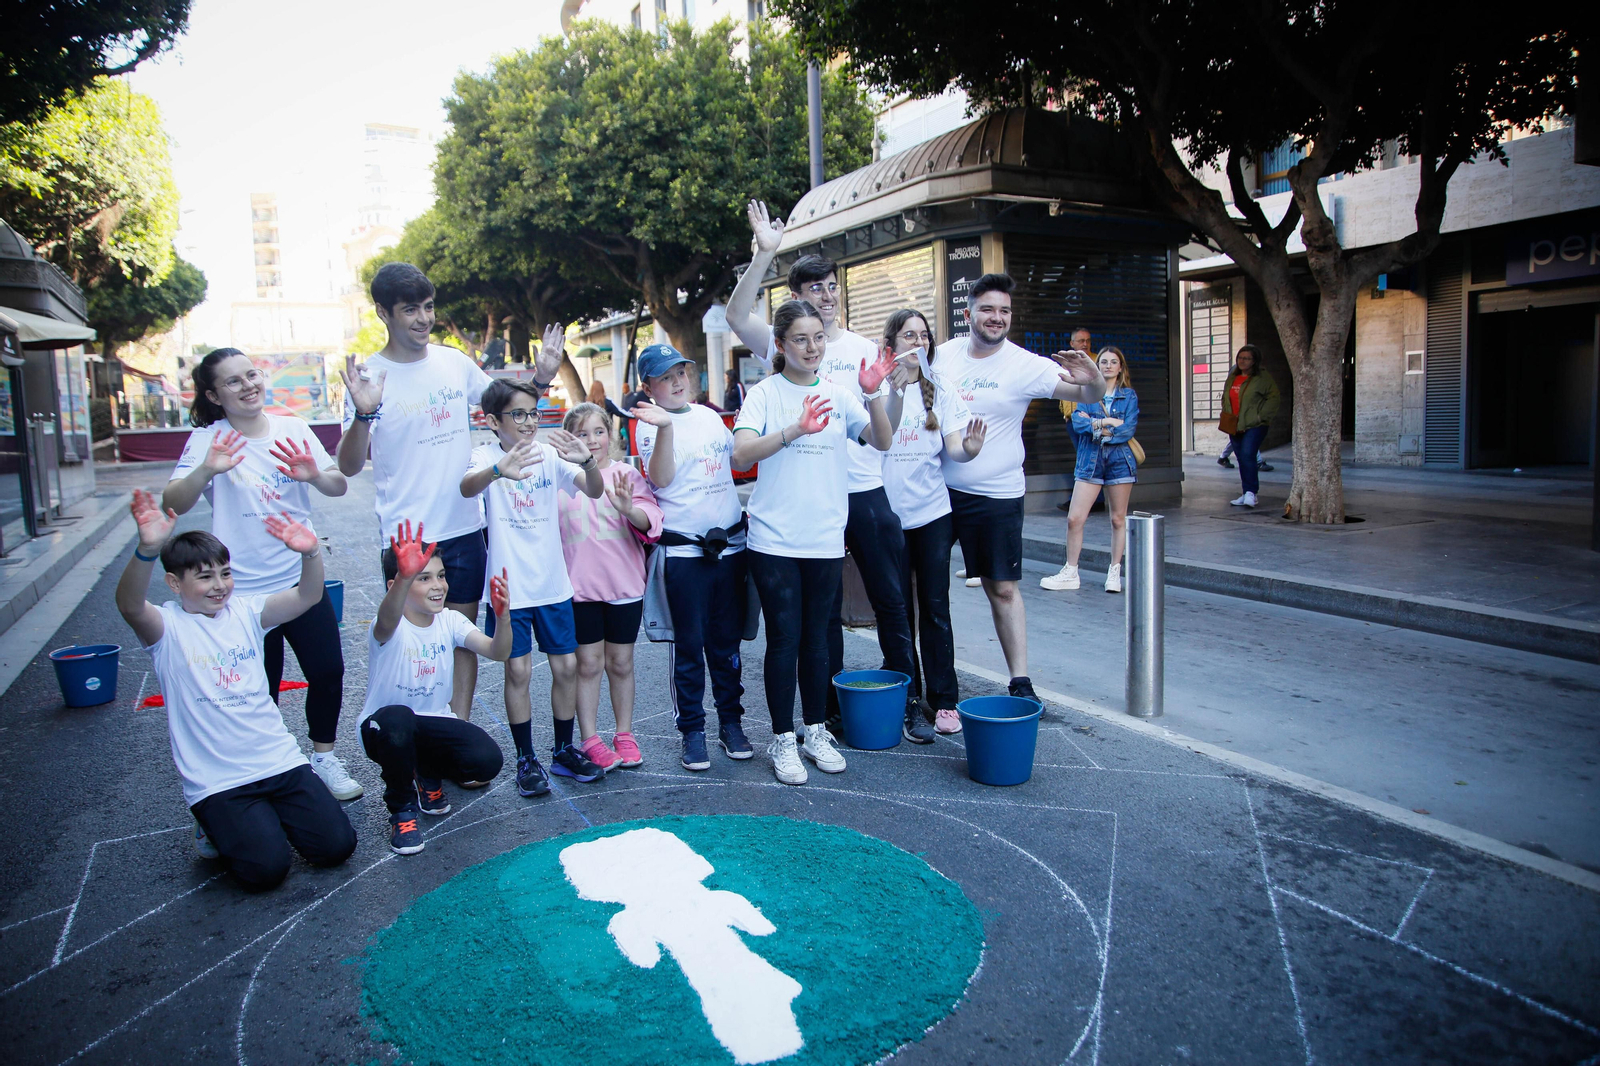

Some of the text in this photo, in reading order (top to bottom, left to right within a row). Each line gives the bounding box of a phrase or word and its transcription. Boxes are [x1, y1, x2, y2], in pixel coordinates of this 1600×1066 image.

[949, 251, 980, 261] TROYANO
[952, 283, 970, 292] LOTU
[952, 296, 968, 304] CAS
[429, 391, 438, 406] de
[902, 415, 912, 427] de
[421, 644, 430, 658] de
